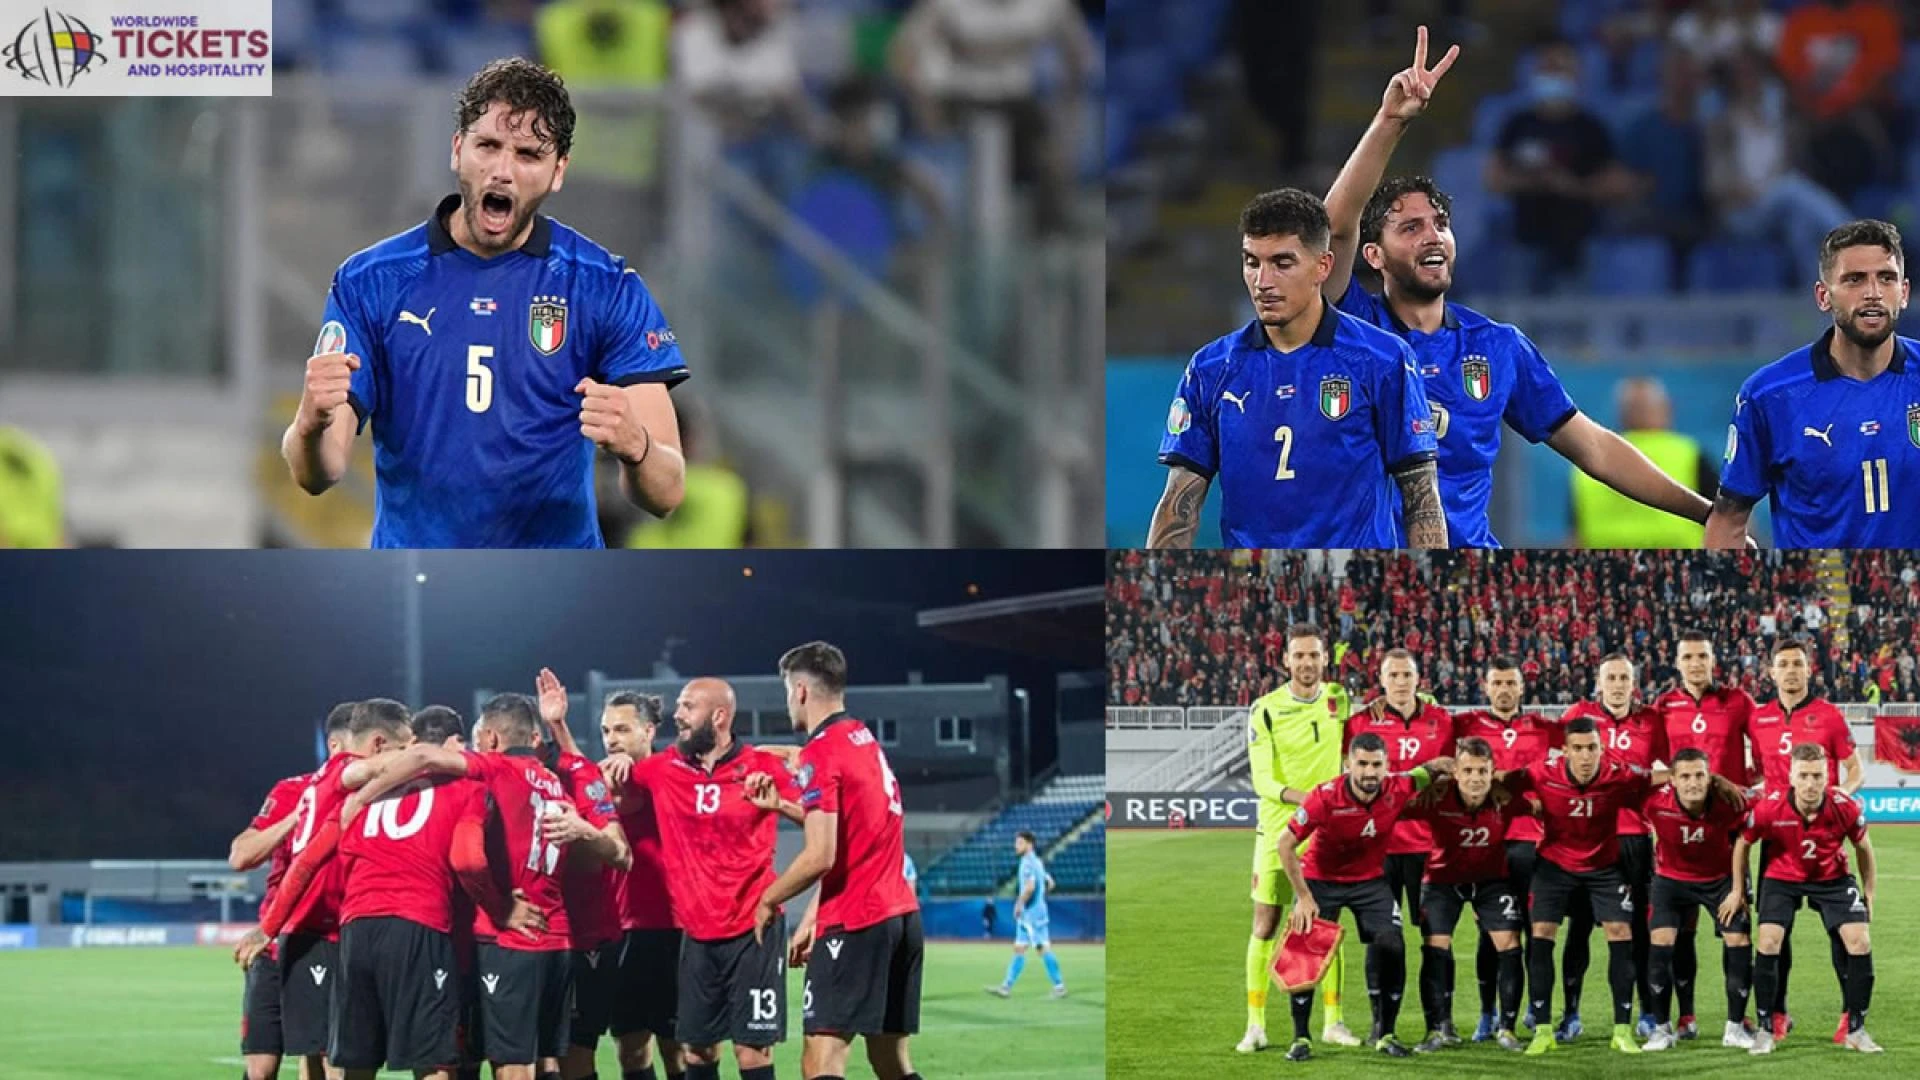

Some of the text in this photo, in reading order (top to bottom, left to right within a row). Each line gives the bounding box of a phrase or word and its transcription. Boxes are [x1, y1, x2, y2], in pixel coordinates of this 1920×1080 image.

[466, 345, 495, 414] 5
[1274, 425, 1295, 481] 2
[1861, 458, 1890, 514] 11
[1310, 720, 1320, 743] 1
[1692, 713, 1707, 734] 6
[1398, 738, 1421, 761] 19
[1502, 729, 1517, 749] 9
[1607, 727, 1632, 750] 16
[1778, 732, 1793, 755] 5
[363, 778, 435, 840] 10
[694, 783, 722, 814] 13
[1568, 800, 1593, 817] 21
[1360, 819, 1377, 838] 4
[1459, 827, 1490, 847] 22
[1680, 826, 1705, 844] 14
[1801, 840, 1817, 859] 2
[1847, 887, 1864, 907] 2
[749, 988, 777, 1020] 13
